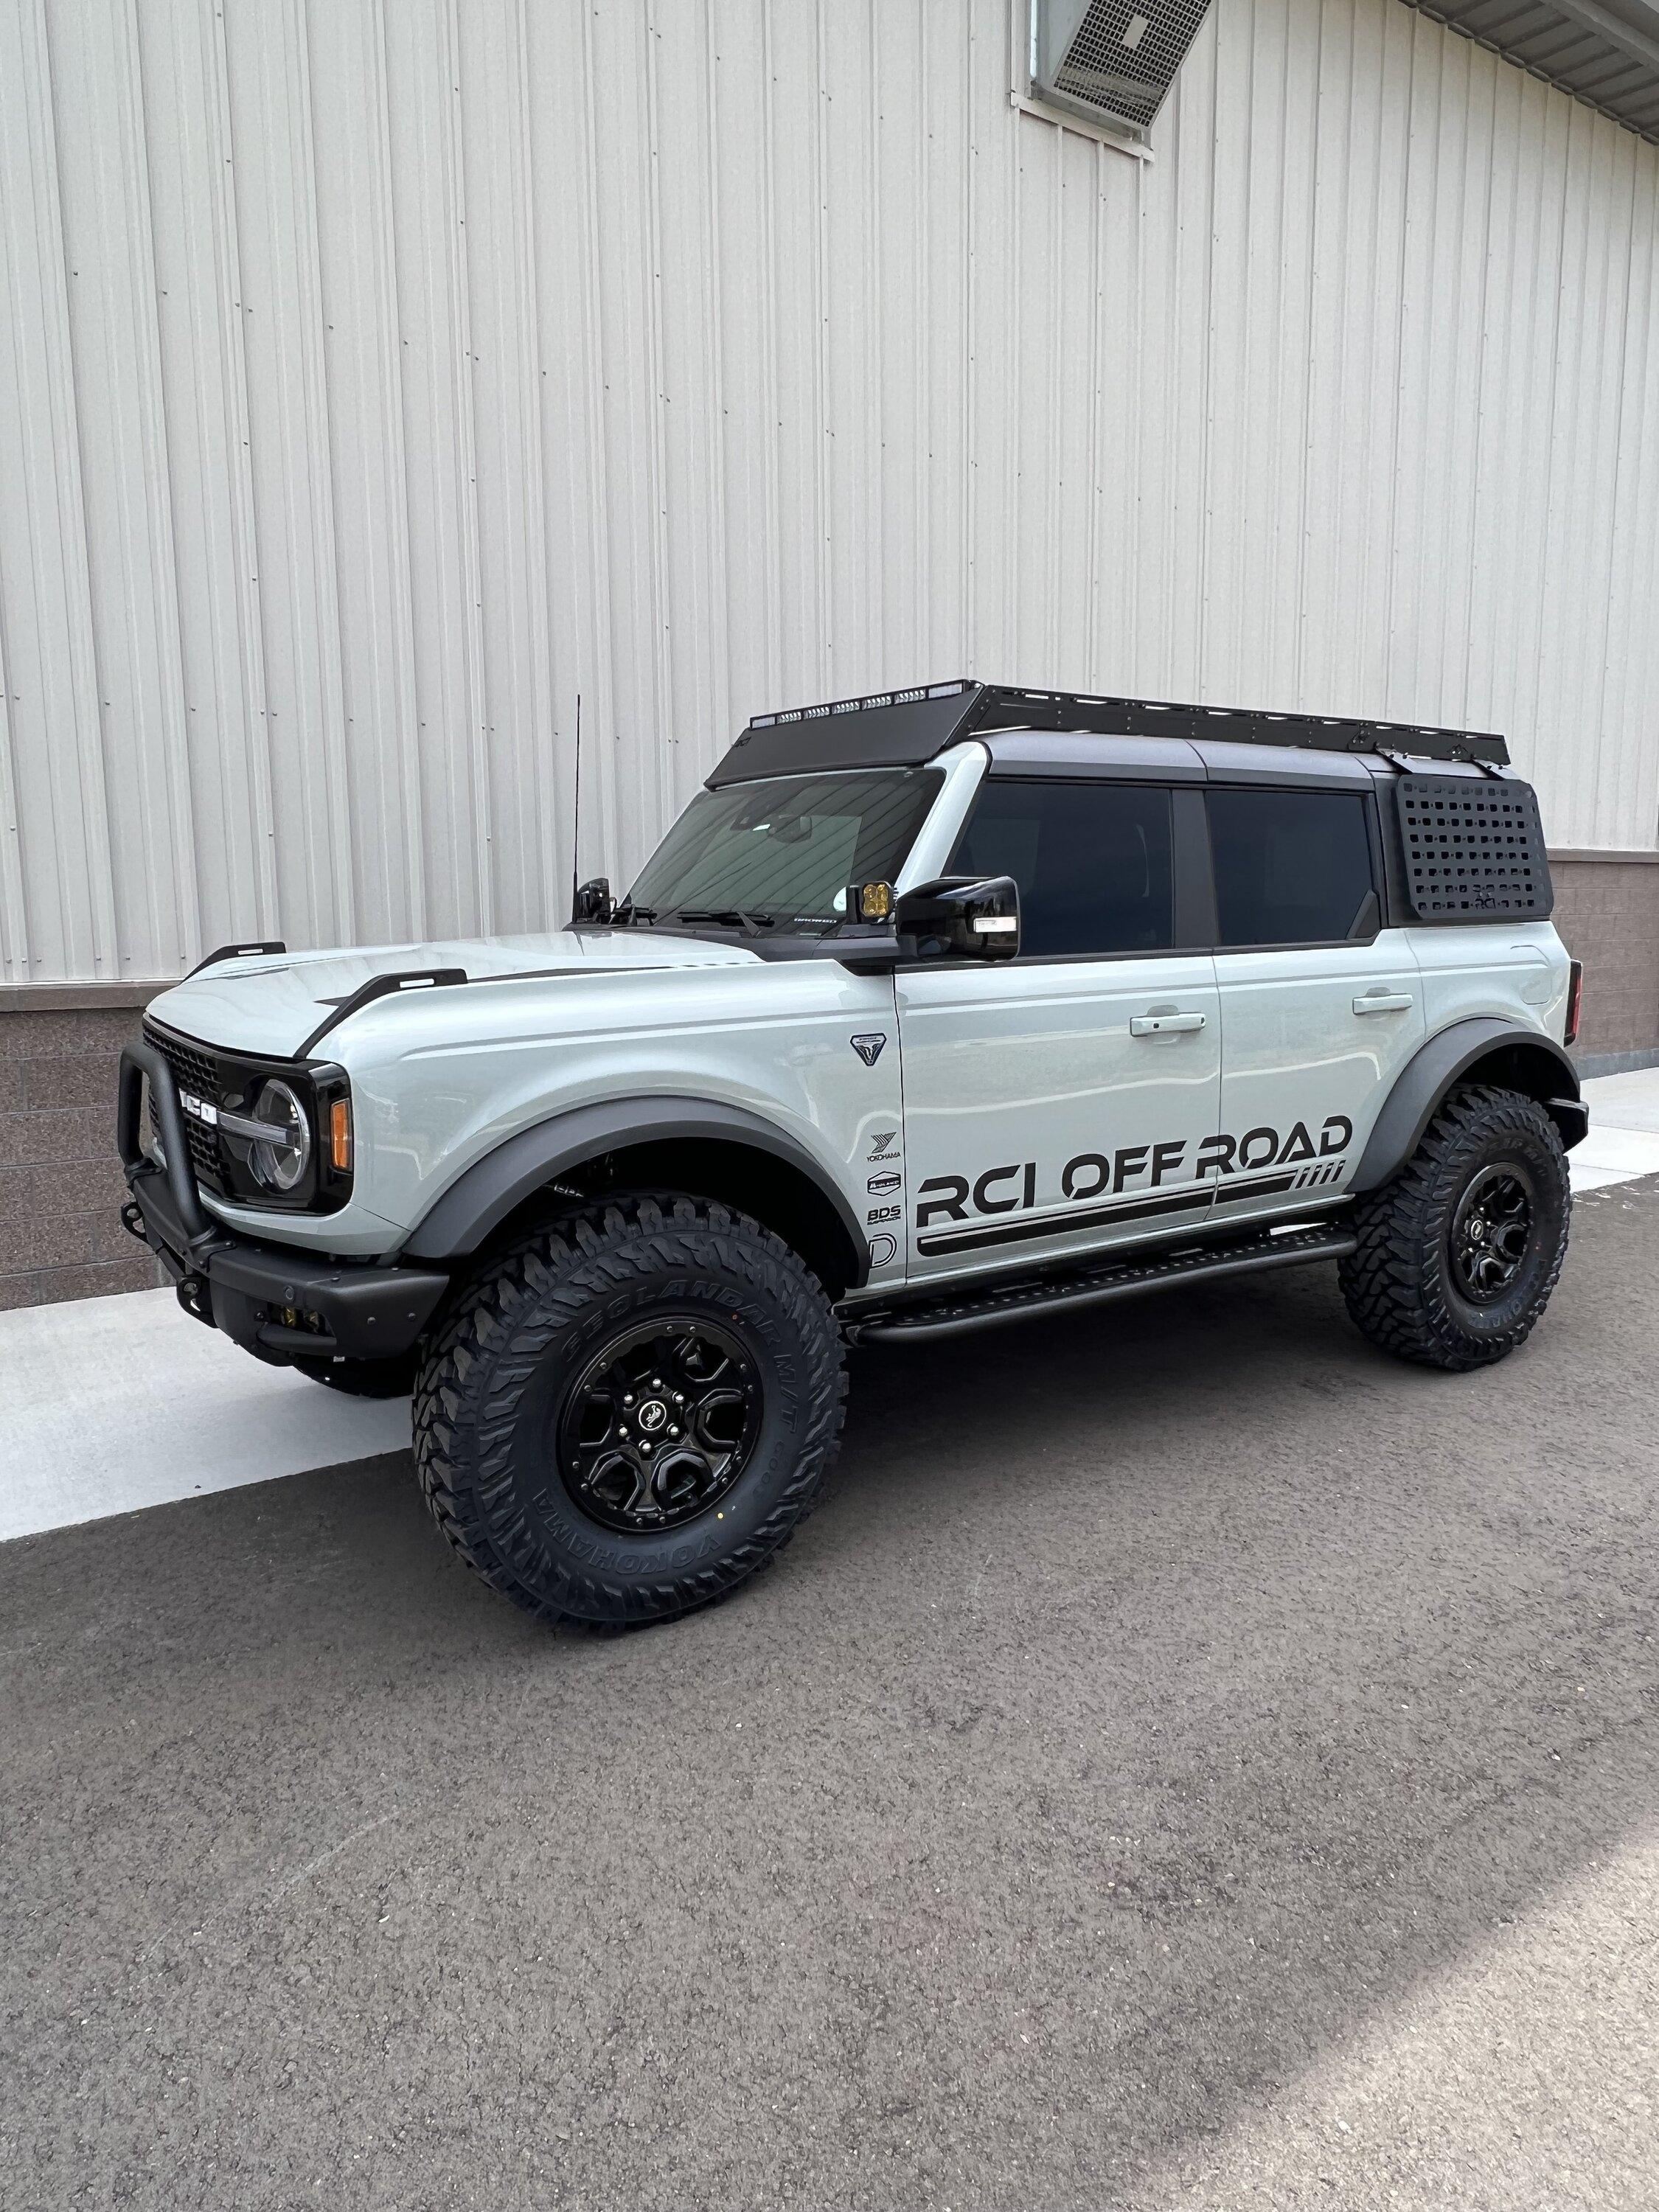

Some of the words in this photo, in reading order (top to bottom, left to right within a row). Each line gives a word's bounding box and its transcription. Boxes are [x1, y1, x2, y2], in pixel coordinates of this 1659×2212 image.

[867, 1205, 901, 1222] BDS
[916, 1161, 1037, 1228] RCI
[1061, 1140, 1188, 1200] OFF
[1194, 1115, 1353, 1180] ROAD
[562, 1279, 782, 1363] GEOLANDAR
[773, 1354, 799, 1434] M/T
[532, 1487, 722, 1575] YOKOHAMA
